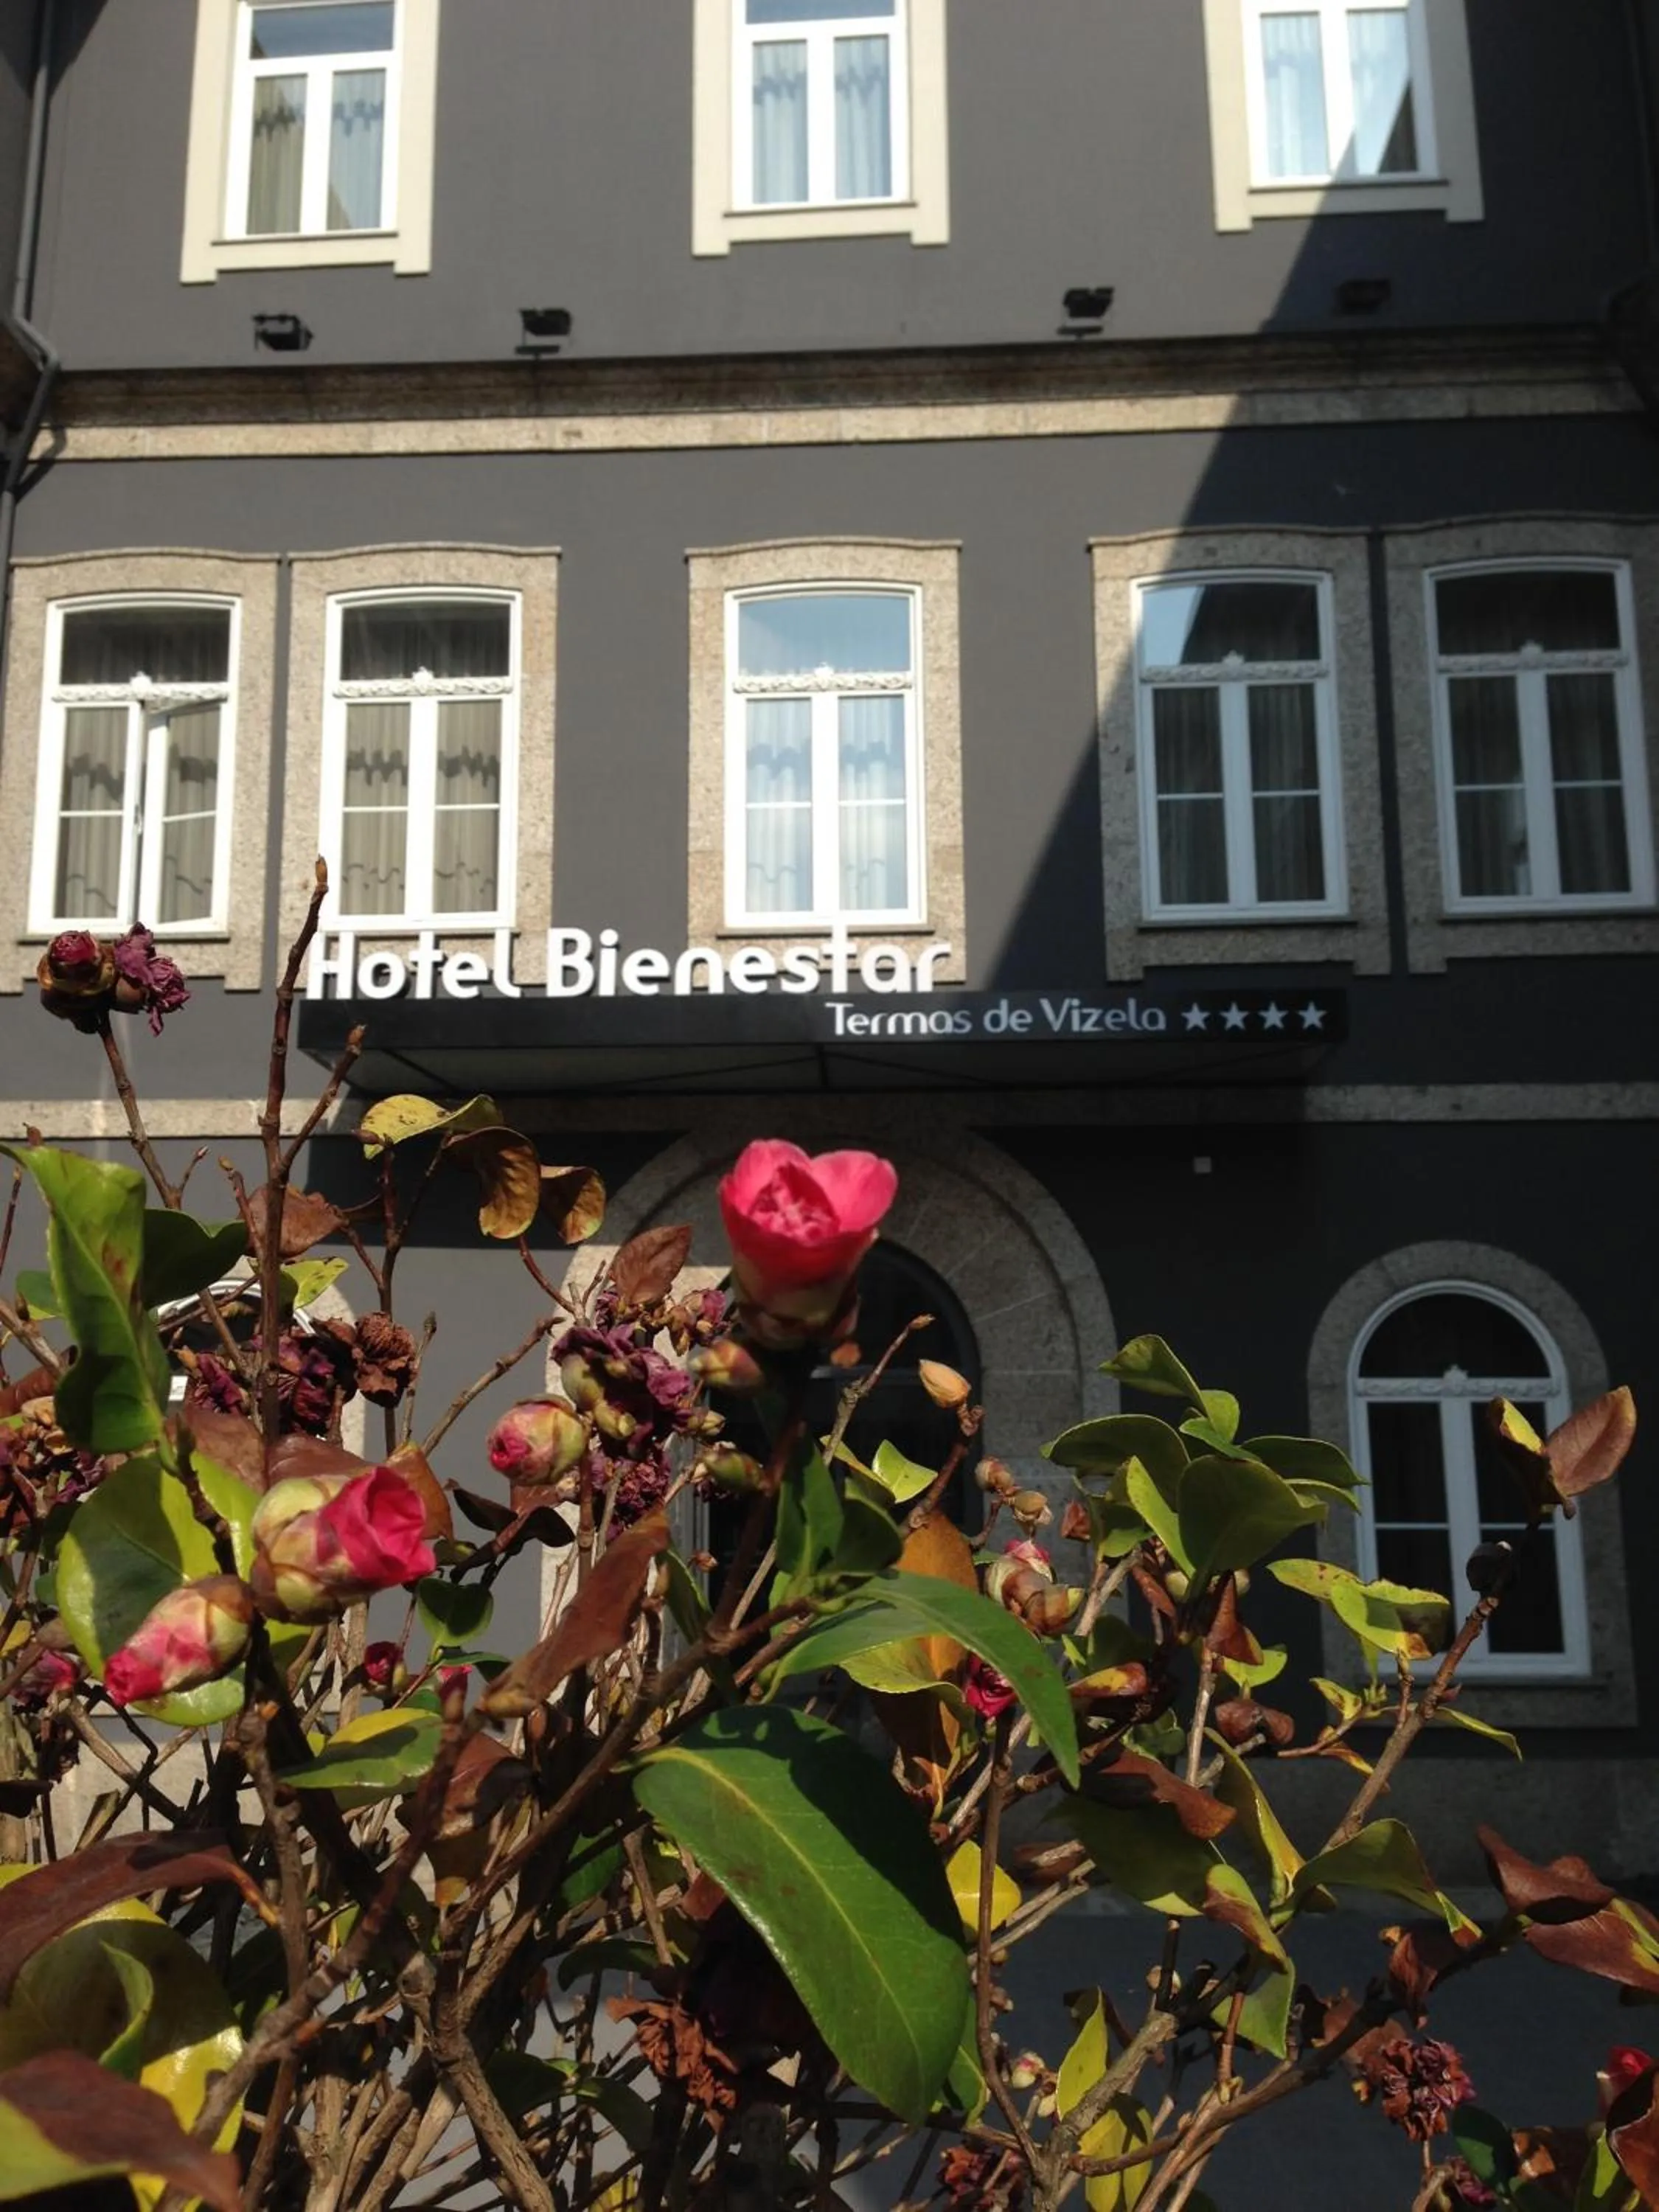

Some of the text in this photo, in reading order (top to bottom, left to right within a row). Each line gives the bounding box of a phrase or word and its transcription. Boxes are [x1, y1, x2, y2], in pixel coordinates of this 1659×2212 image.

[306, 925, 952, 1000] Hotel Bienestar
[824, 998, 1167, 1036] Termas de Vizela
